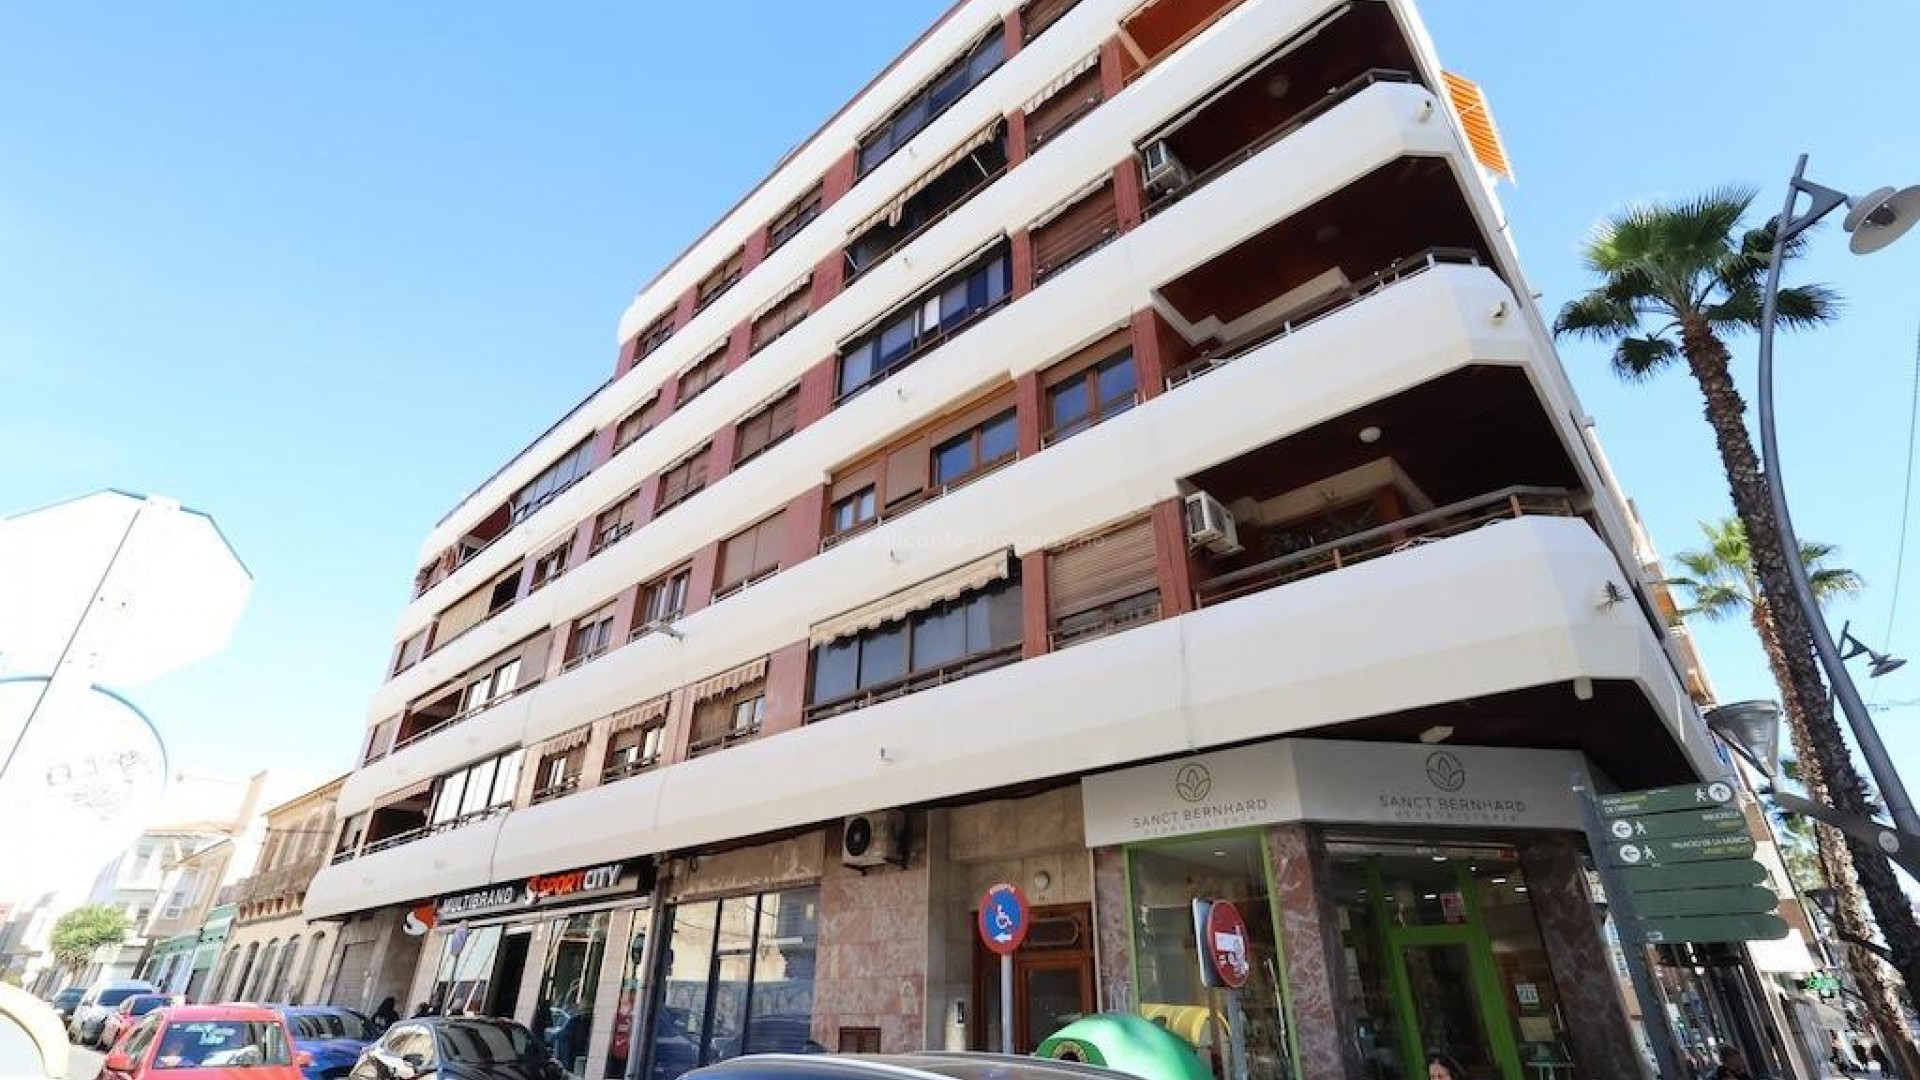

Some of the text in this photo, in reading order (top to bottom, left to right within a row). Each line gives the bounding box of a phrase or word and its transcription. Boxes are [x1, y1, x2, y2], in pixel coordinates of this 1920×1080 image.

[1133, 799, 1268, 828] SANCT BERNHARD
[1379, 795, 1527, 813] SANCT BERNHARD
[443, 885, 515, 913] MULTIBRAND
